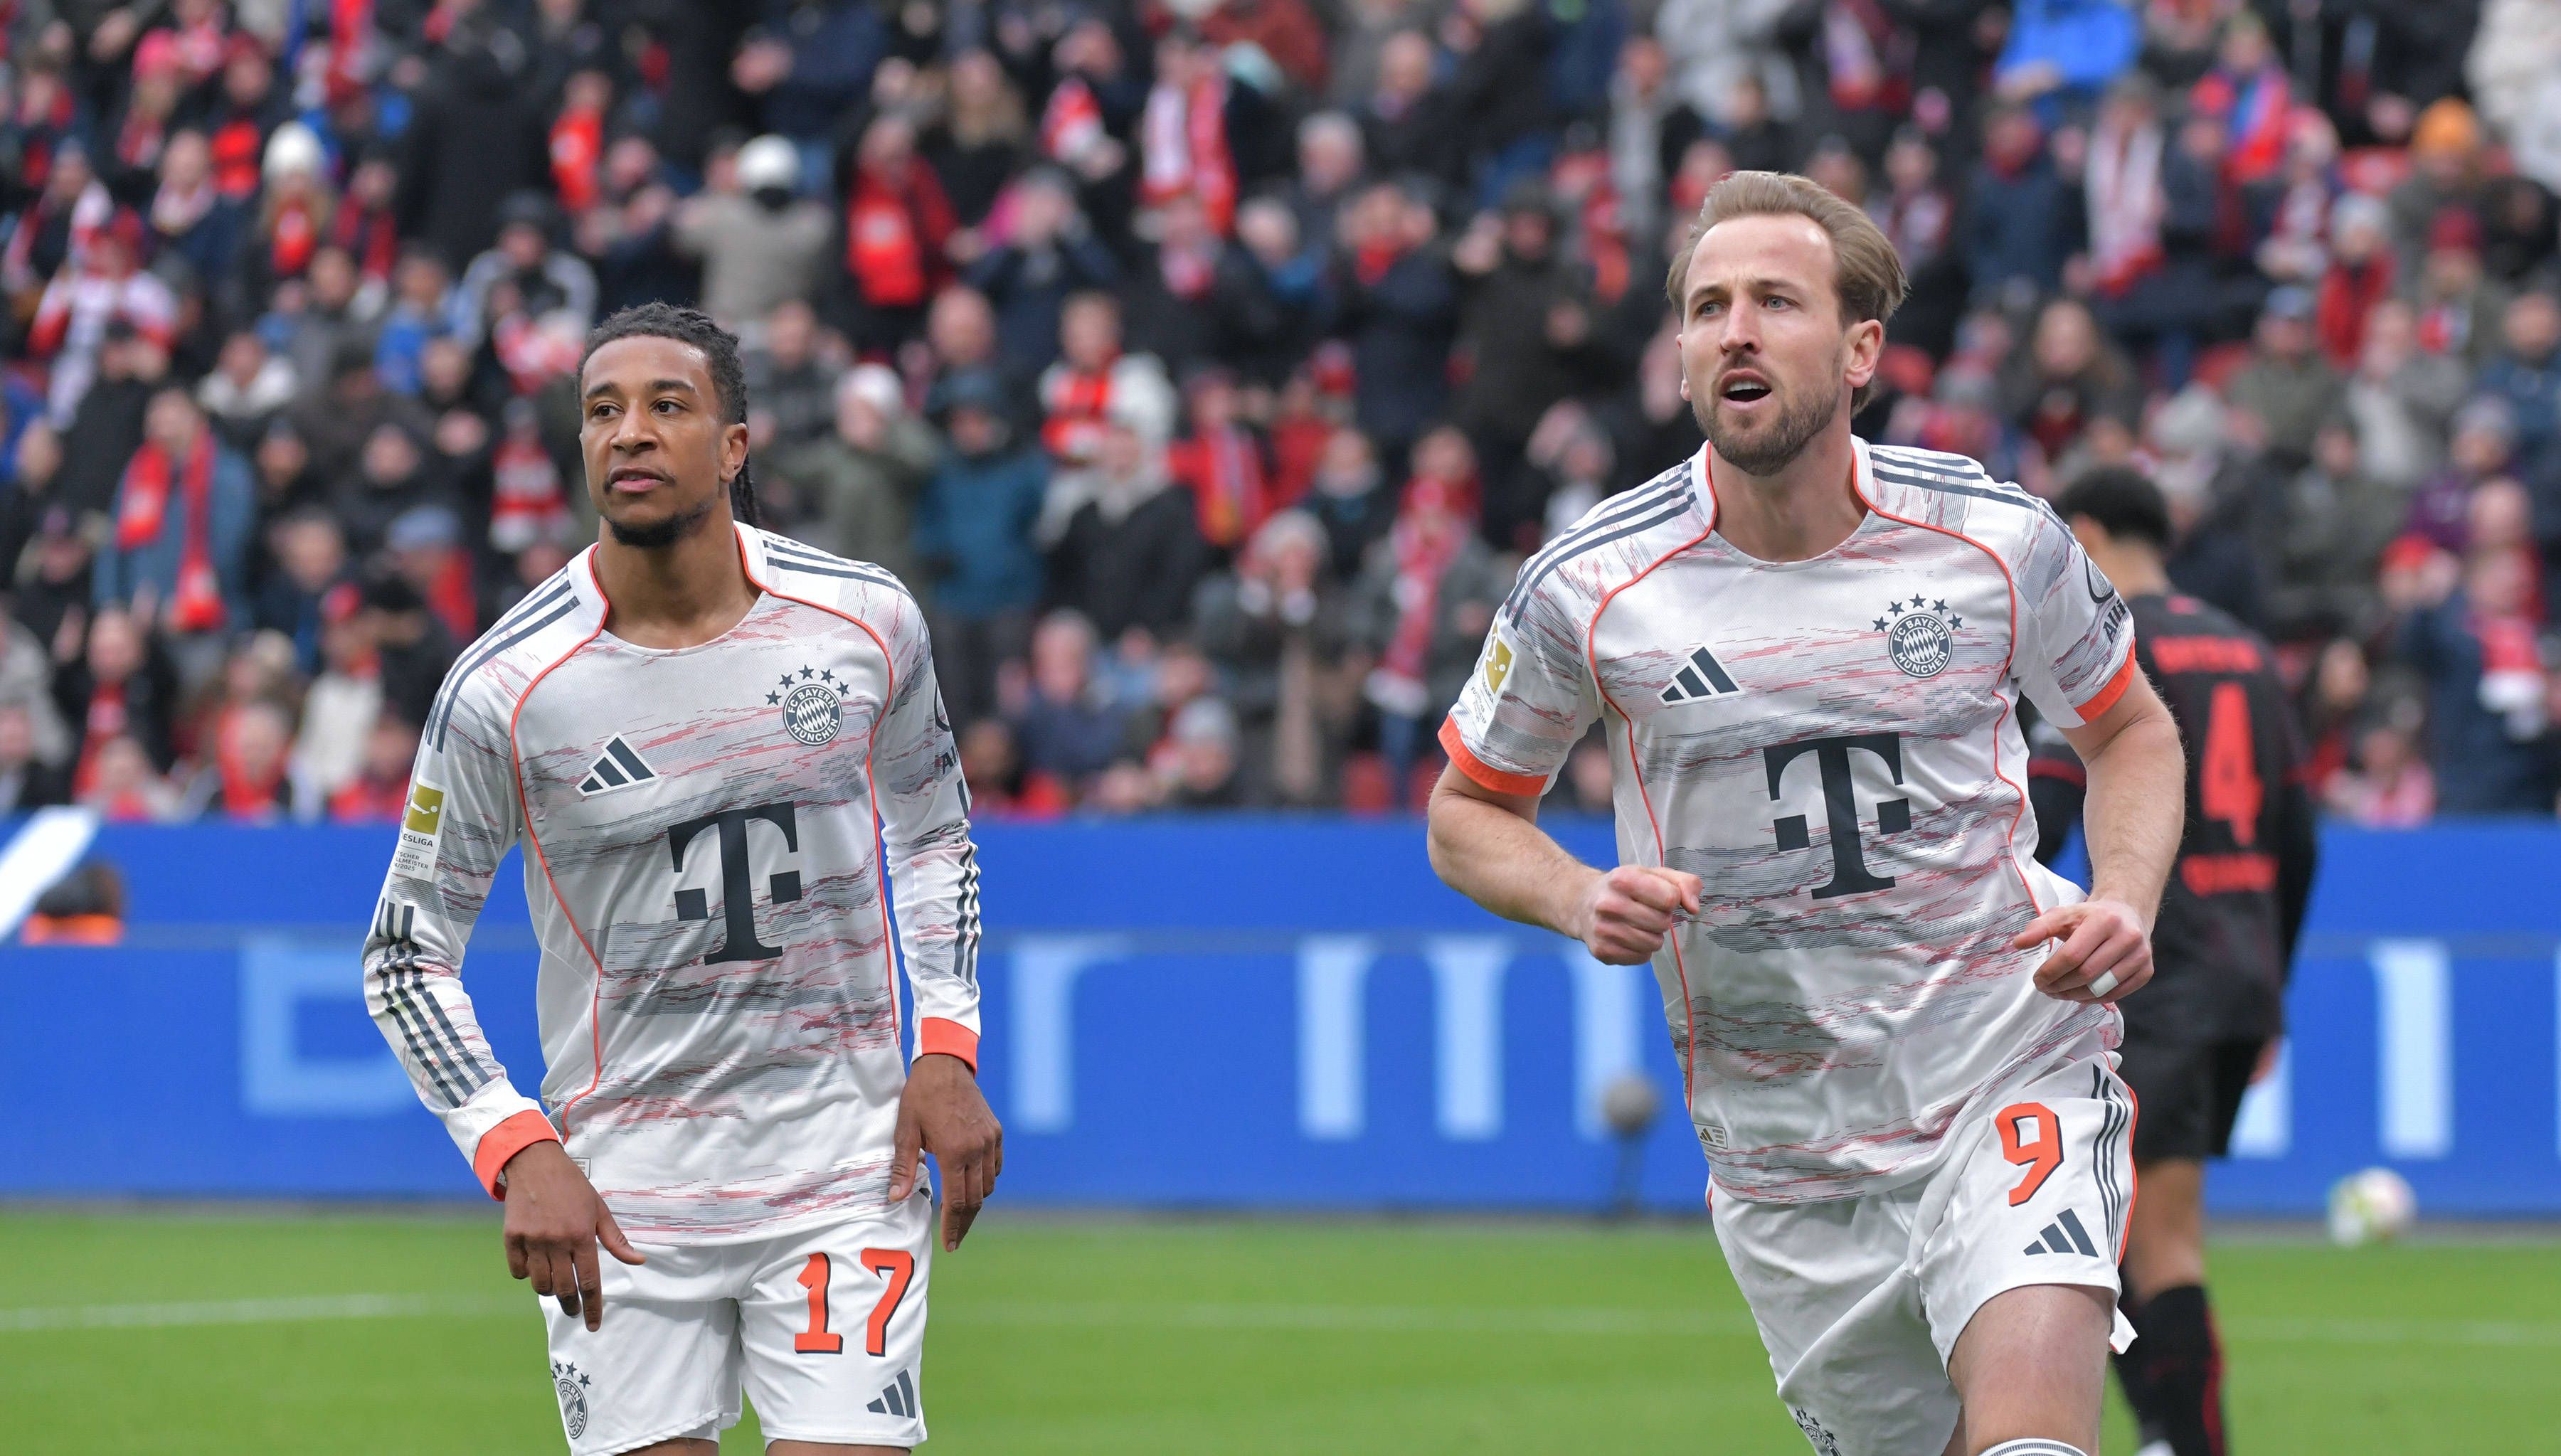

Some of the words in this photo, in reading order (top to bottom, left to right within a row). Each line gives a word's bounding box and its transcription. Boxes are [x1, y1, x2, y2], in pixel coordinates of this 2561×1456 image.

[1894, 627, 1906, 642] FC
[1905, 618, 1946, 641] BAYERN
[2103, 599, 2126, 644] Alli
[788, 699, 798, 713] FC
[797, 689, 836, 708] BAYERN
[1764, 732, 1912, 899] T
[398, 851, 420, 860] SCHER
[403, 833, 433, 847] ESLIGA
[396, 857, 428, 870] LLMEISTER
[667, 801, 802, 965] T
[1995, 1102, 2064, 1207] 9
[794, 1248, 915, 1356] 17
